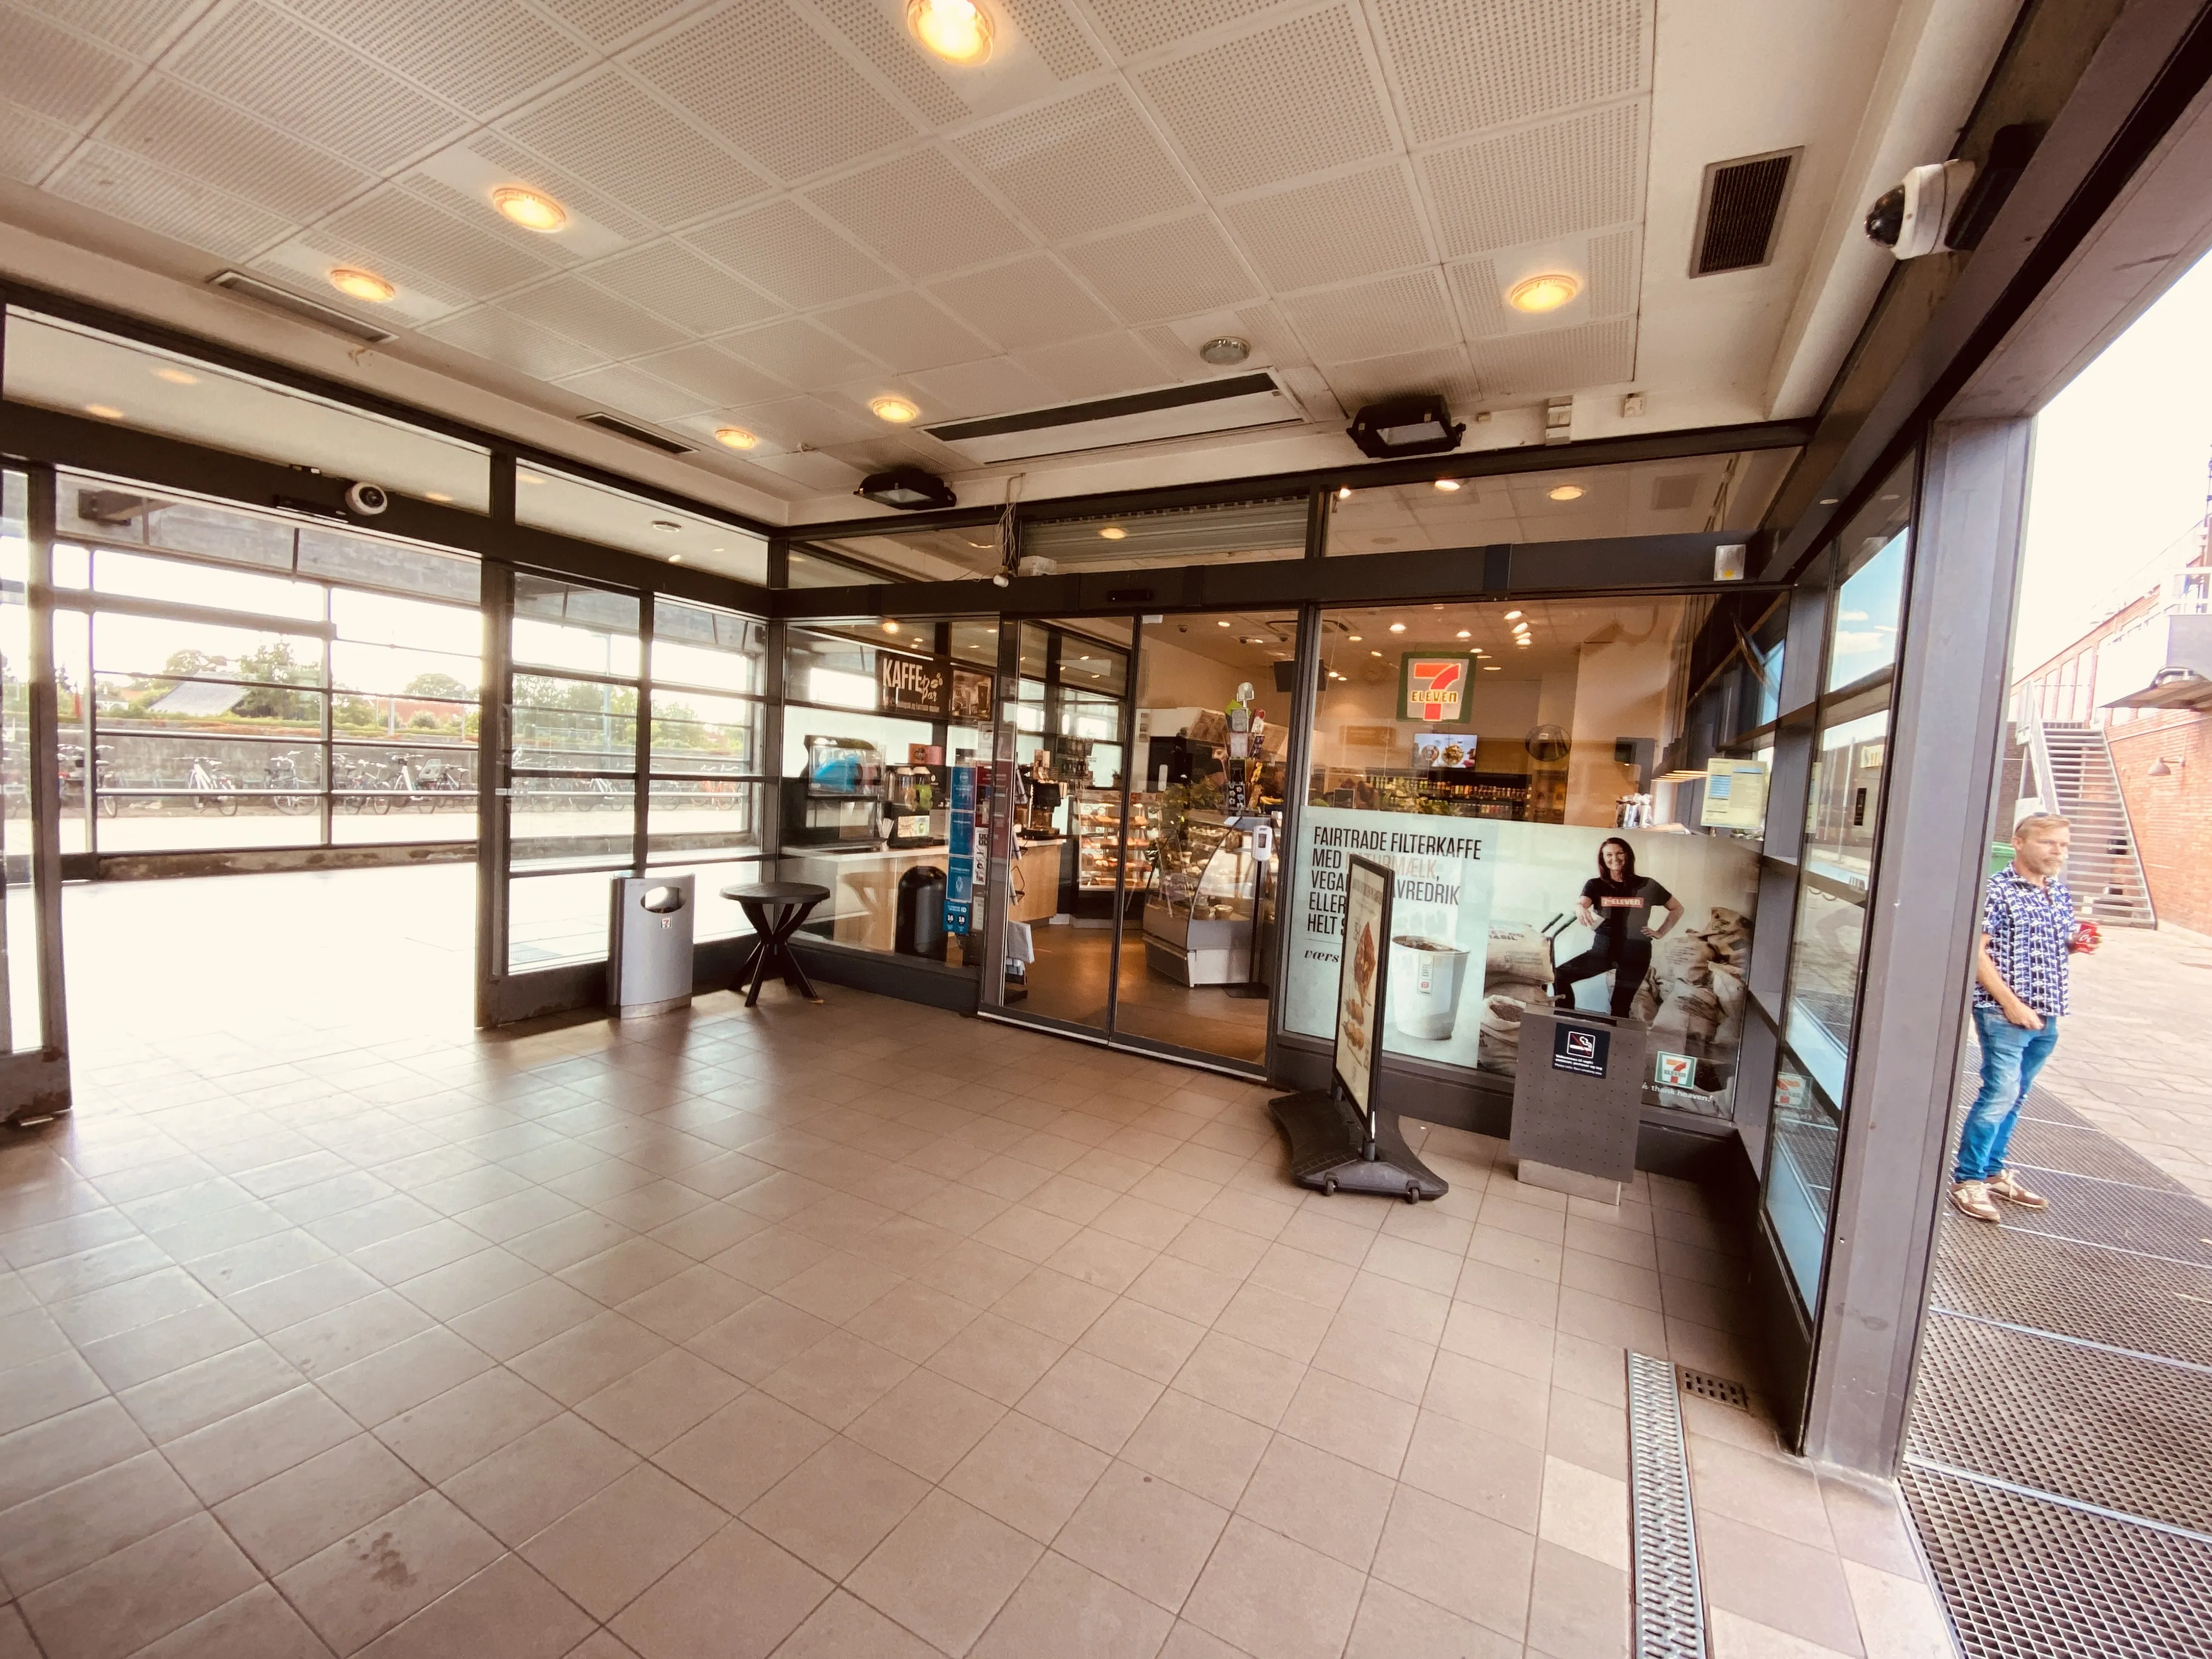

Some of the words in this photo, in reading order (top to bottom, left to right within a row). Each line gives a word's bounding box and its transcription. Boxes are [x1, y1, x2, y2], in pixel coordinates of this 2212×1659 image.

[883, 658, 923, 692] KAFFE
[1413, 663, 1461, 721] 7
[1313, 826, 1387, 851] FAIRTRADE
[1391, 832, 1482, 860] FILTERKAFFE
[1312, 848, 1341, 869] MED
[1311, 869, 1347, 892] VEGA
[1308, 891, 1347, 915] ELLER
[1307, 913, 1338, 935] HELT
[1666, 1058, 1687, 1084] 7
[1651, 1084, 1675, 1096] thank
[1677, 1089, 1715, 1102] heaven!
